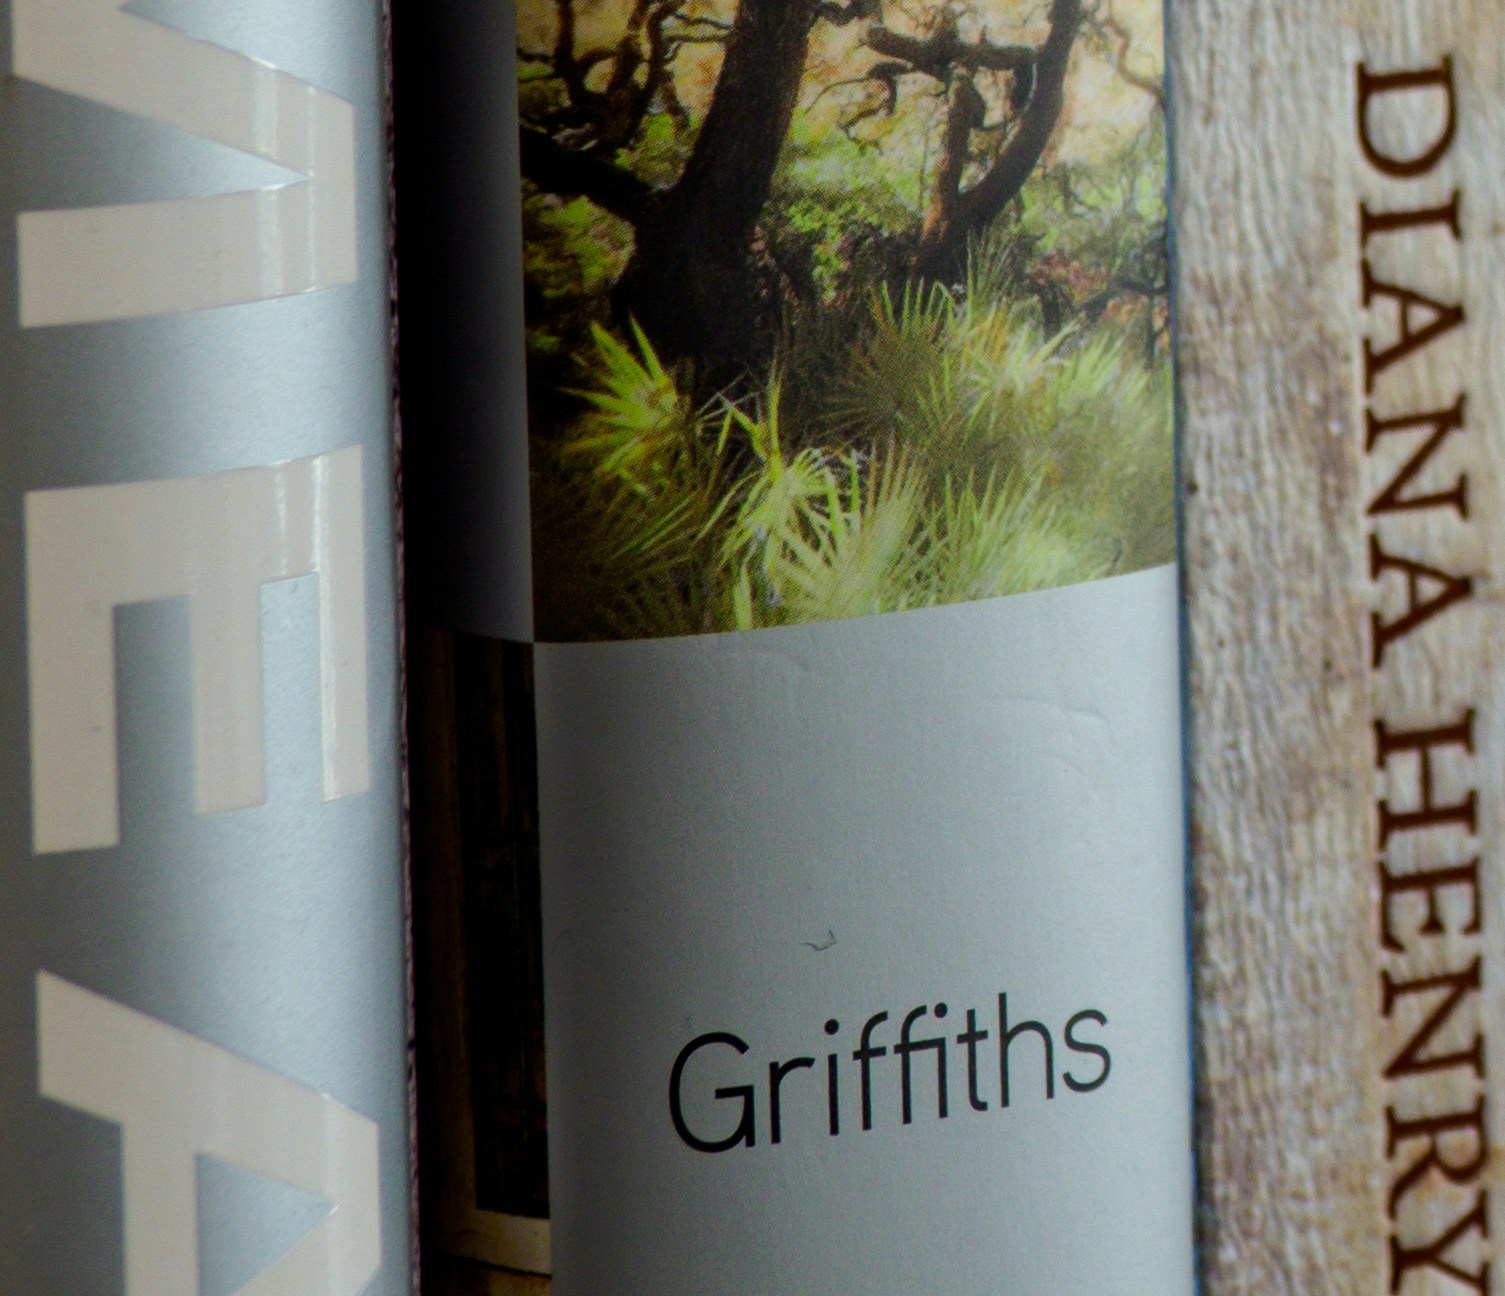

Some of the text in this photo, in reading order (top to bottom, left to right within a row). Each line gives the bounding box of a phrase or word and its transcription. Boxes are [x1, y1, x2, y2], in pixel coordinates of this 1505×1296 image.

[1354, 53, 1494, 1296] DIANA HENRY
[667, 991, 1114, 1154] Griffiths
